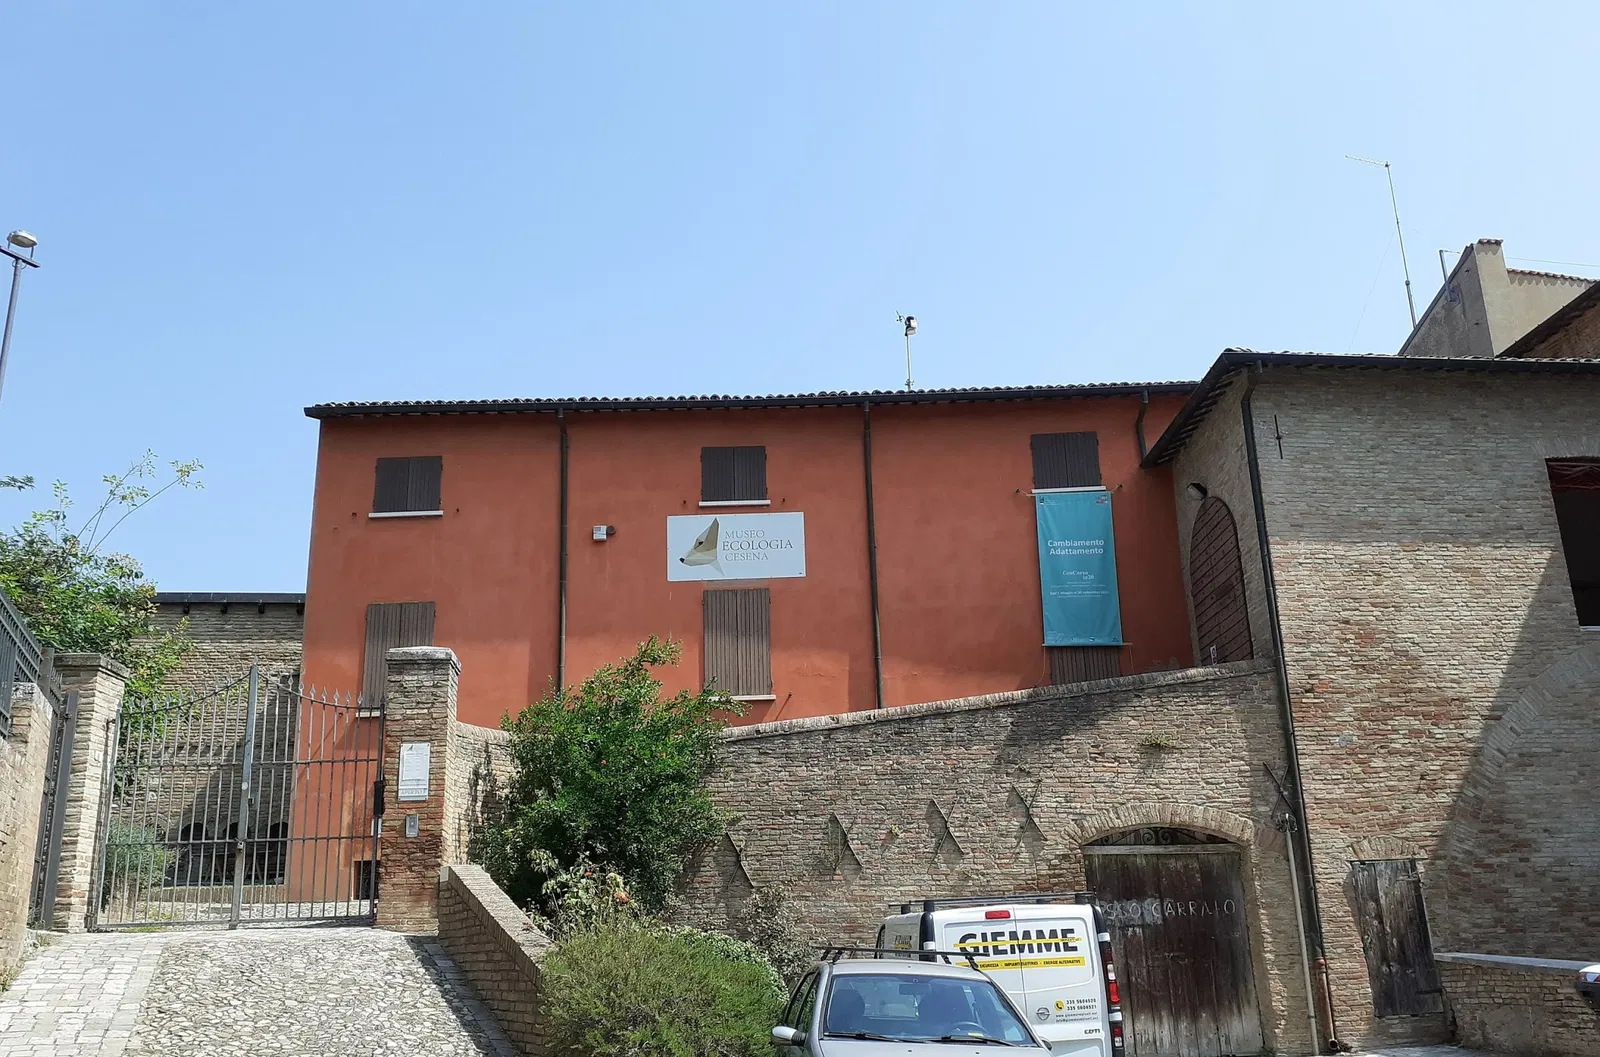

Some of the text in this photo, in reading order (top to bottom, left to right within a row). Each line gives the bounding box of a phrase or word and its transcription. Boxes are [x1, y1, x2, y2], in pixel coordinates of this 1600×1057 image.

[725, 530, 765, 539] MUSEO
[722, 539, 793, 551] ECOLOGIA
[725, 552, 769, 561] CESENA
[1151, 899, 1236, 917] CARRAIO
[959, 929, 1077, 955] GIEMME
